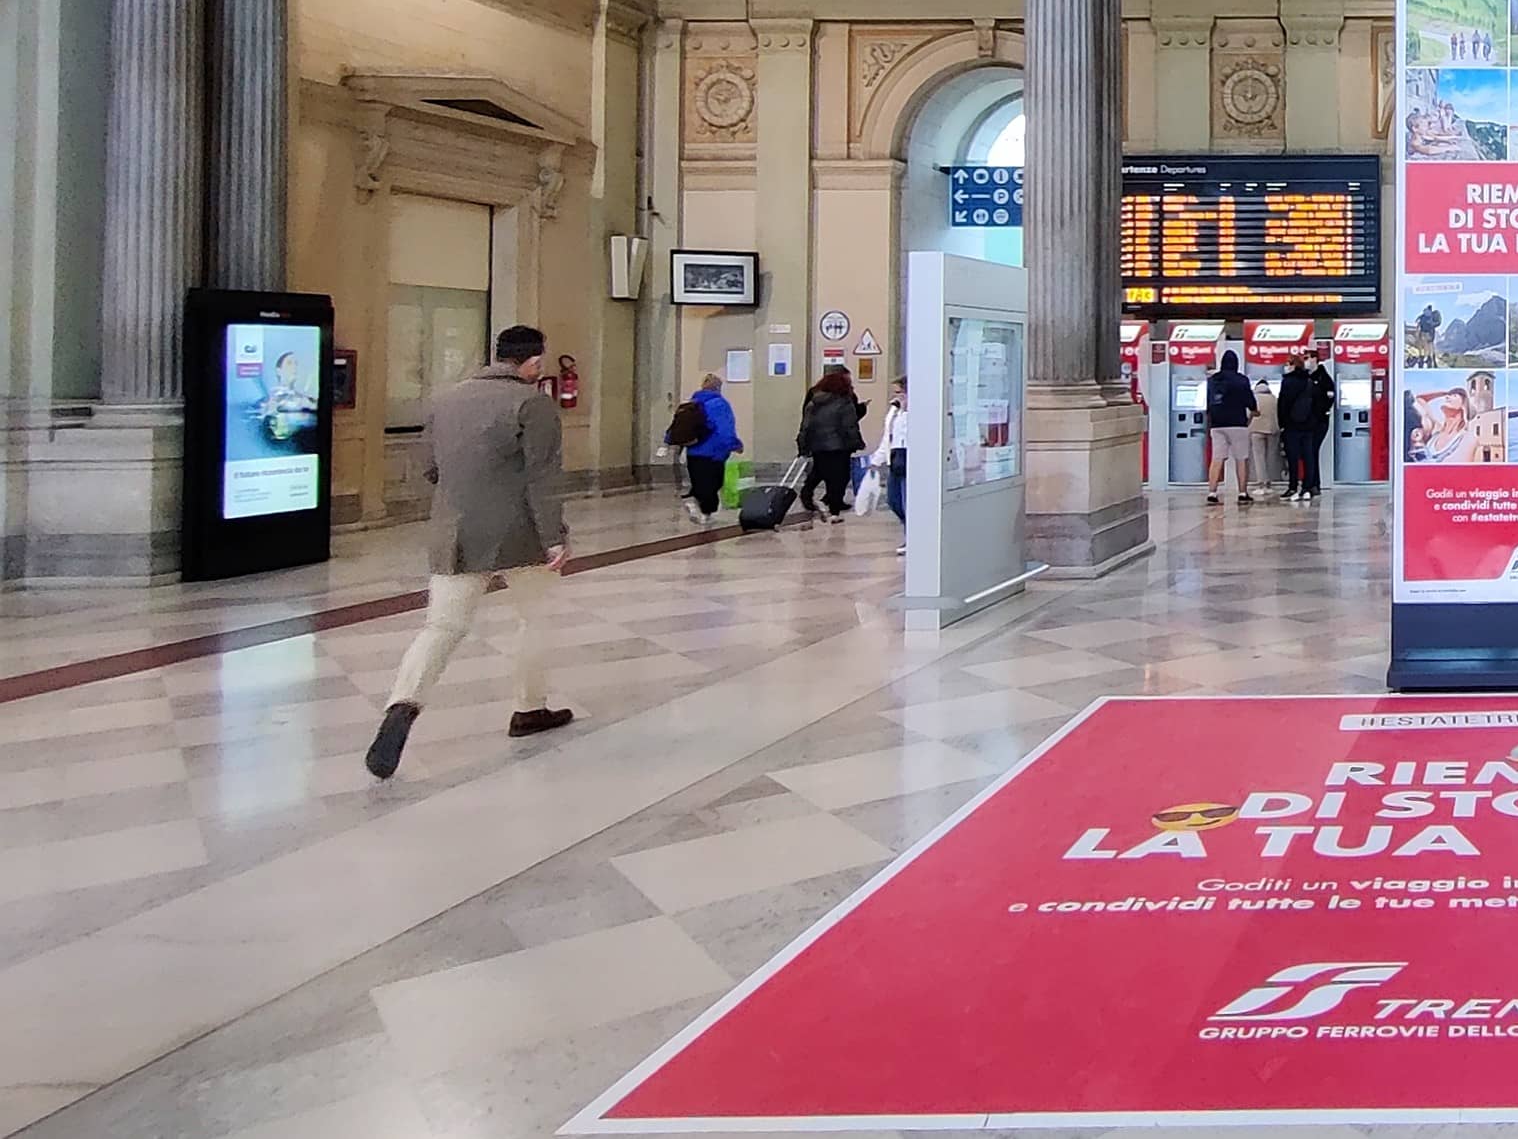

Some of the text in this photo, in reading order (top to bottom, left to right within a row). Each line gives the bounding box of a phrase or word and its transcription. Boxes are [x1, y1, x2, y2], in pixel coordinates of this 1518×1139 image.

[1448, 208, 1473, 228] DI
[1418, 233, 1450, 253] LA
[1457, 233, 1508, 253] TUA
[1426, 488, 1453, 499] Goditi
[1469, 488, 1509, 500] viaggio
[1442, 500, 1490, 510] condividi
[1493, 500, 1517, 510] tutte
[1452, 514, 1468, 522] con
[1239, 791, 1346, 819] DI
[1063, 828, 1207, 859] LA
[1255, 825, 1481, 858] TUA
[1198, 877, 1293, 892] Goditi
[1303, 880, 1338, 891] un
[1350, 876, 1490, 893] viaggio
[1008, 901, 1029, 912] e
[1038, 896, 1216, 912] condividi
[1227, 896, 1315, 910] tutte
[1327, 895, 1362, 909] le
[1375, 896, 1435, 909] tue
[1199, 1026, 1309, 1040] GRUPPO
[1316, 1025, 1440, 1038] FERROVIE
